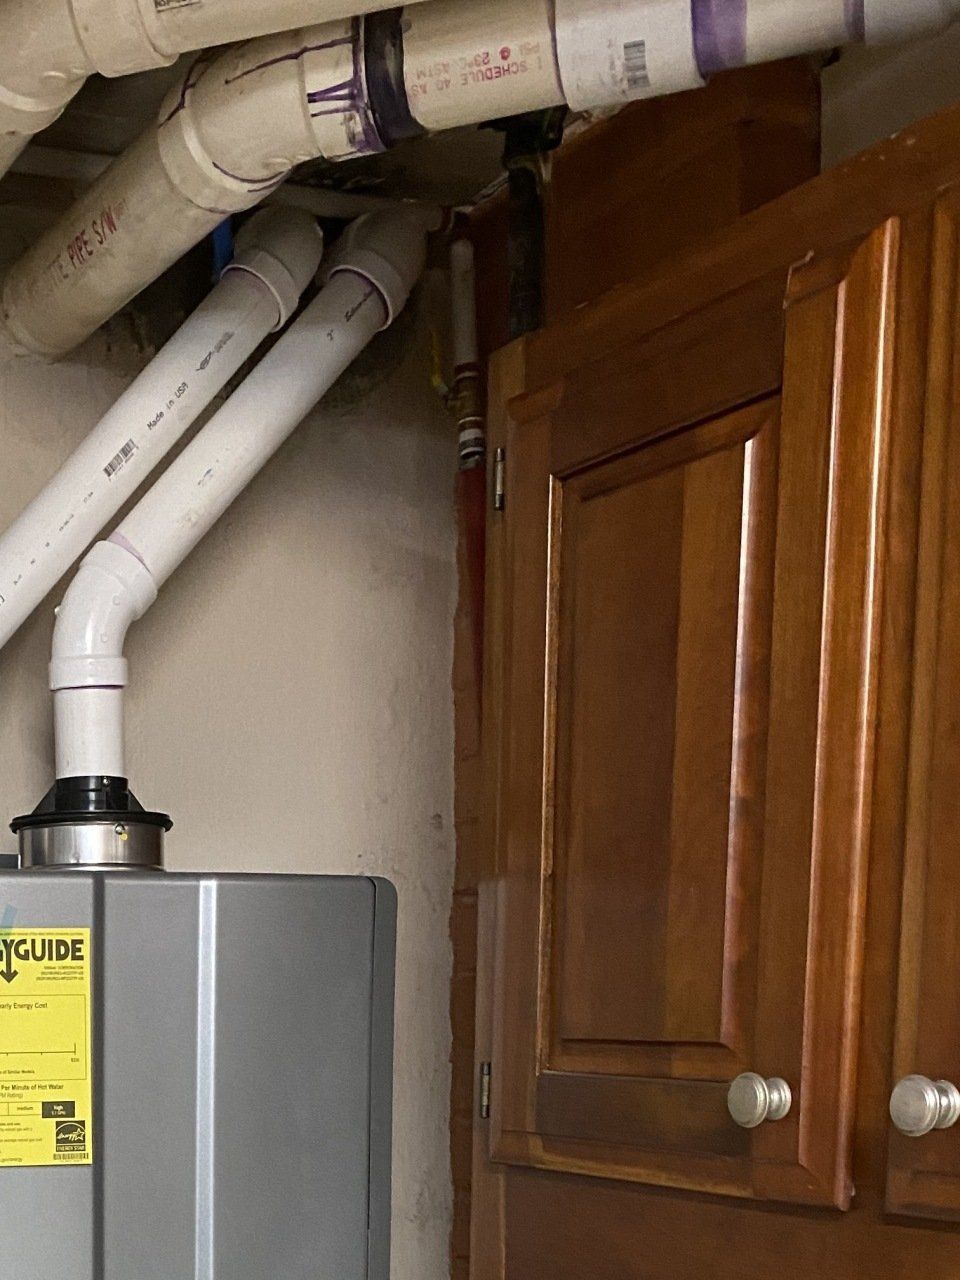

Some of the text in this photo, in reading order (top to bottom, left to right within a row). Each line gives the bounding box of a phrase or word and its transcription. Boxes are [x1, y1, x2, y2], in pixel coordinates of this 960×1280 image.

[461, 60, 529, 86] SCHEDULE
[67, 229, 94, 269] PIPE
[146, 382, 188, 430] Made in USA
[13, 1002, 33, 1011] Energy
